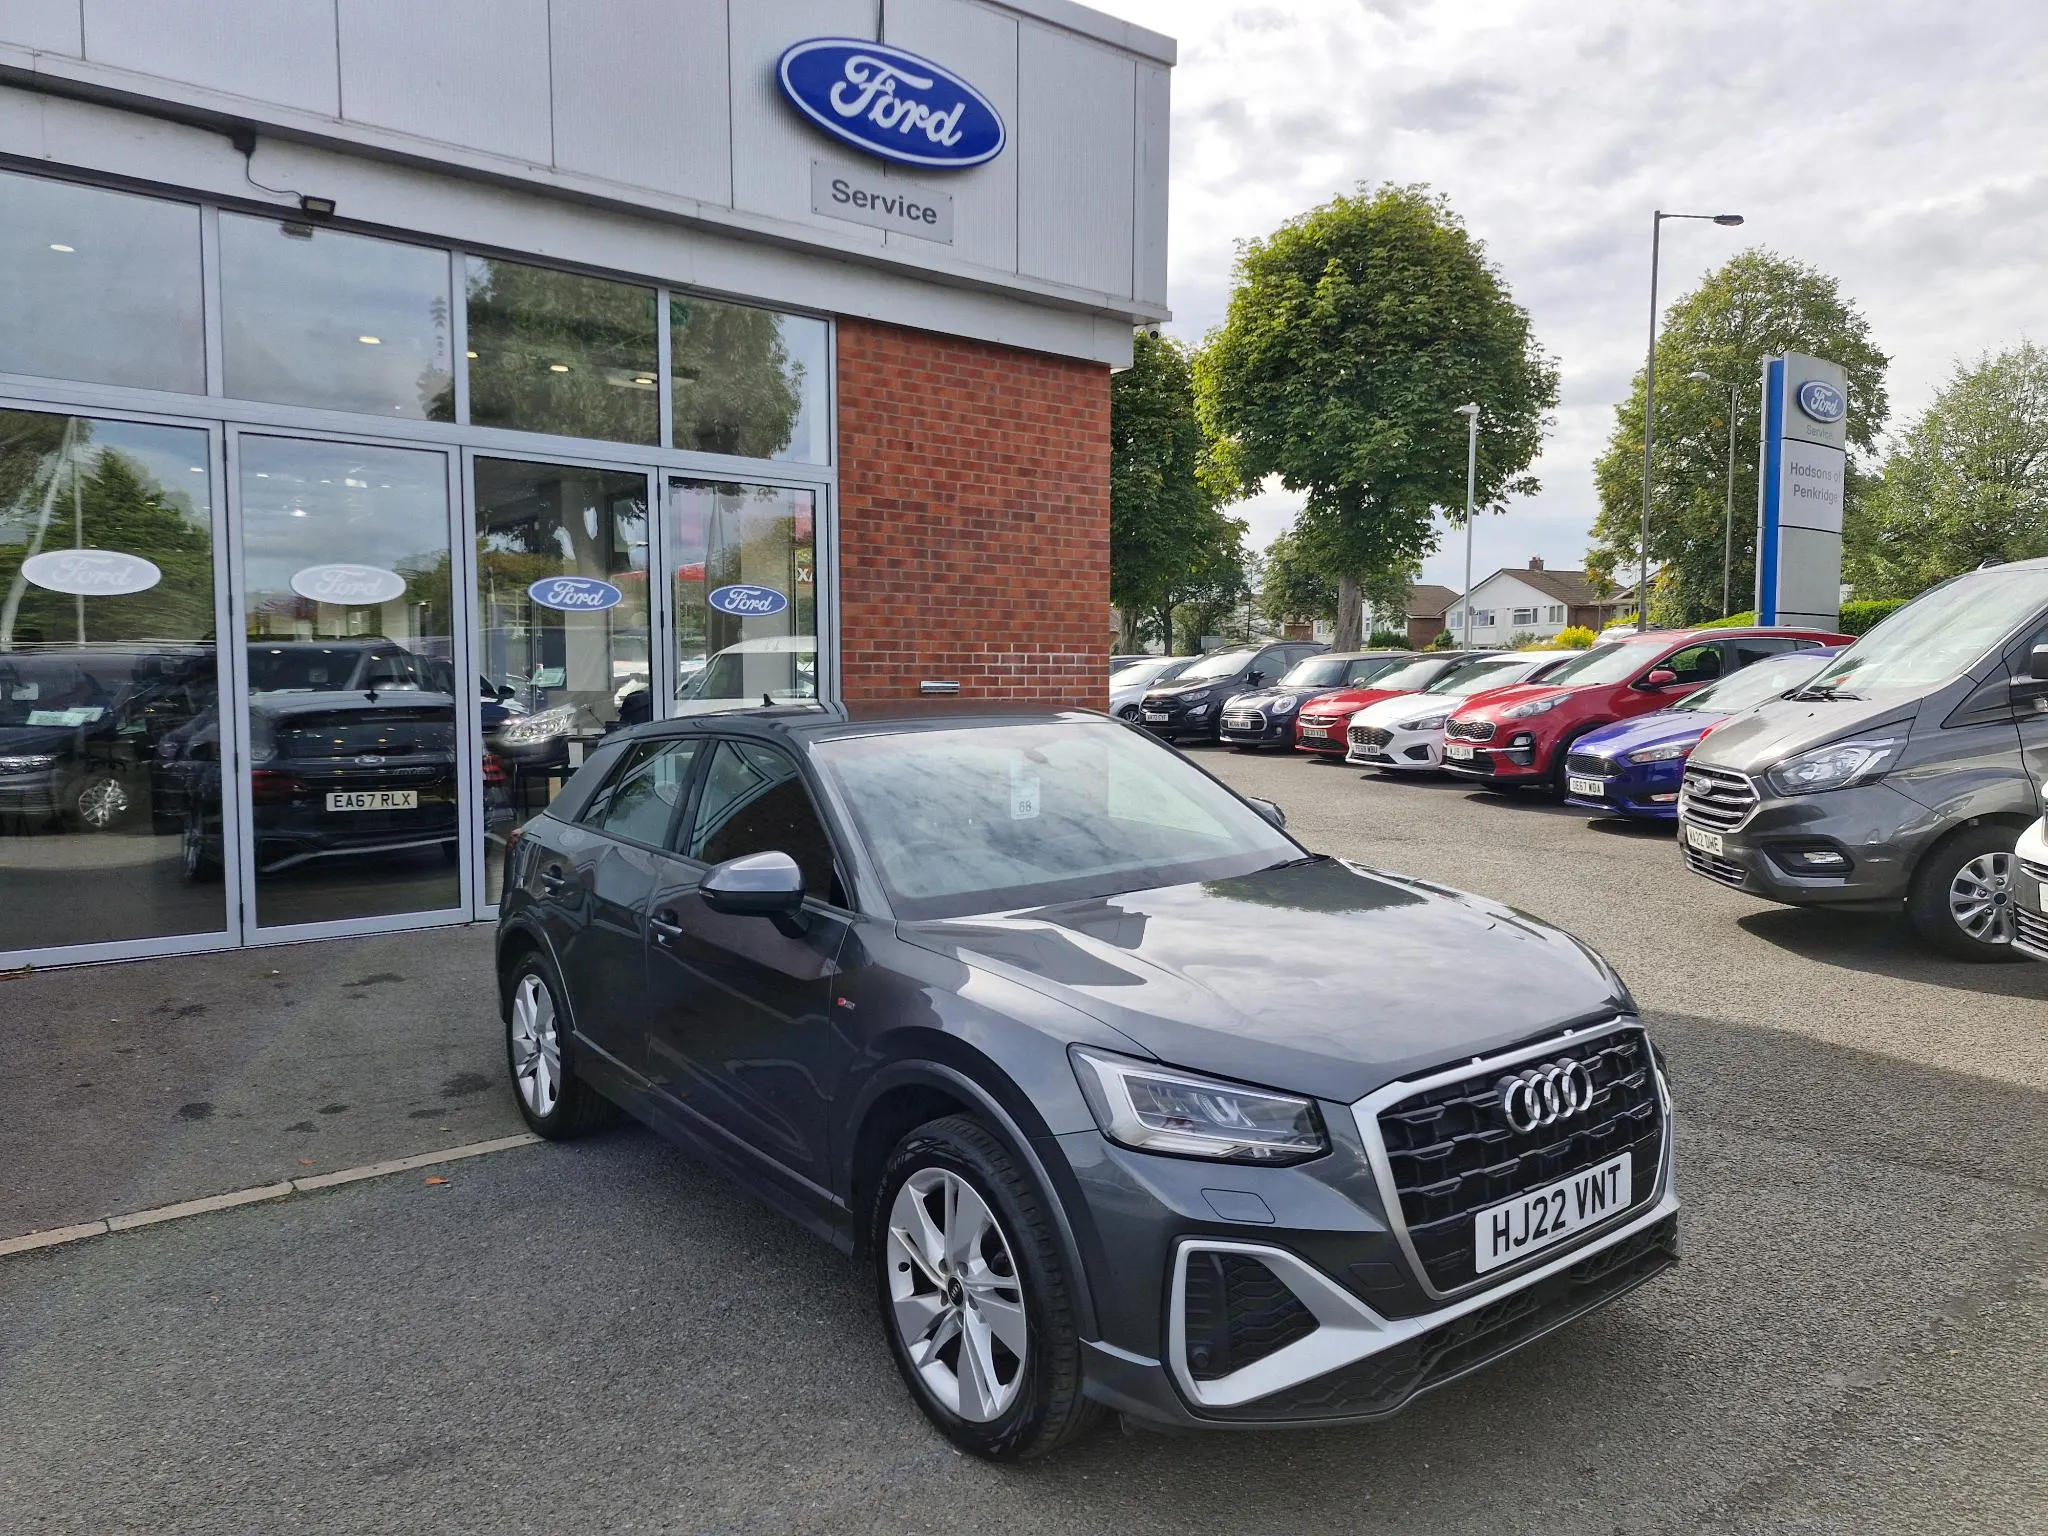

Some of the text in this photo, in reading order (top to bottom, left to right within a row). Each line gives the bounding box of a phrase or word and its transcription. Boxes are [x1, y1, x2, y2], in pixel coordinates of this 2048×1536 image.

[830, 54, 966, 148] Ford
[831, 178, 938, 225] Service
[1811, 386, 1839, 416] Ford
[1806, 425, 1833, 441] Service
[1790, 461, 1832, 481] Hodsons
[1793, 483, 1838, 505] Penkridge
[52, 554, 133, 588] Ford
[315, 569, 384, 598] Ford
[547, 580, 606, 607] Ford
[724, 588, 773, 612] Ford
[333, 793, 412, 808] EA67 RLX
[1492, 1163, 1621, 1257] HJ22 VNT
